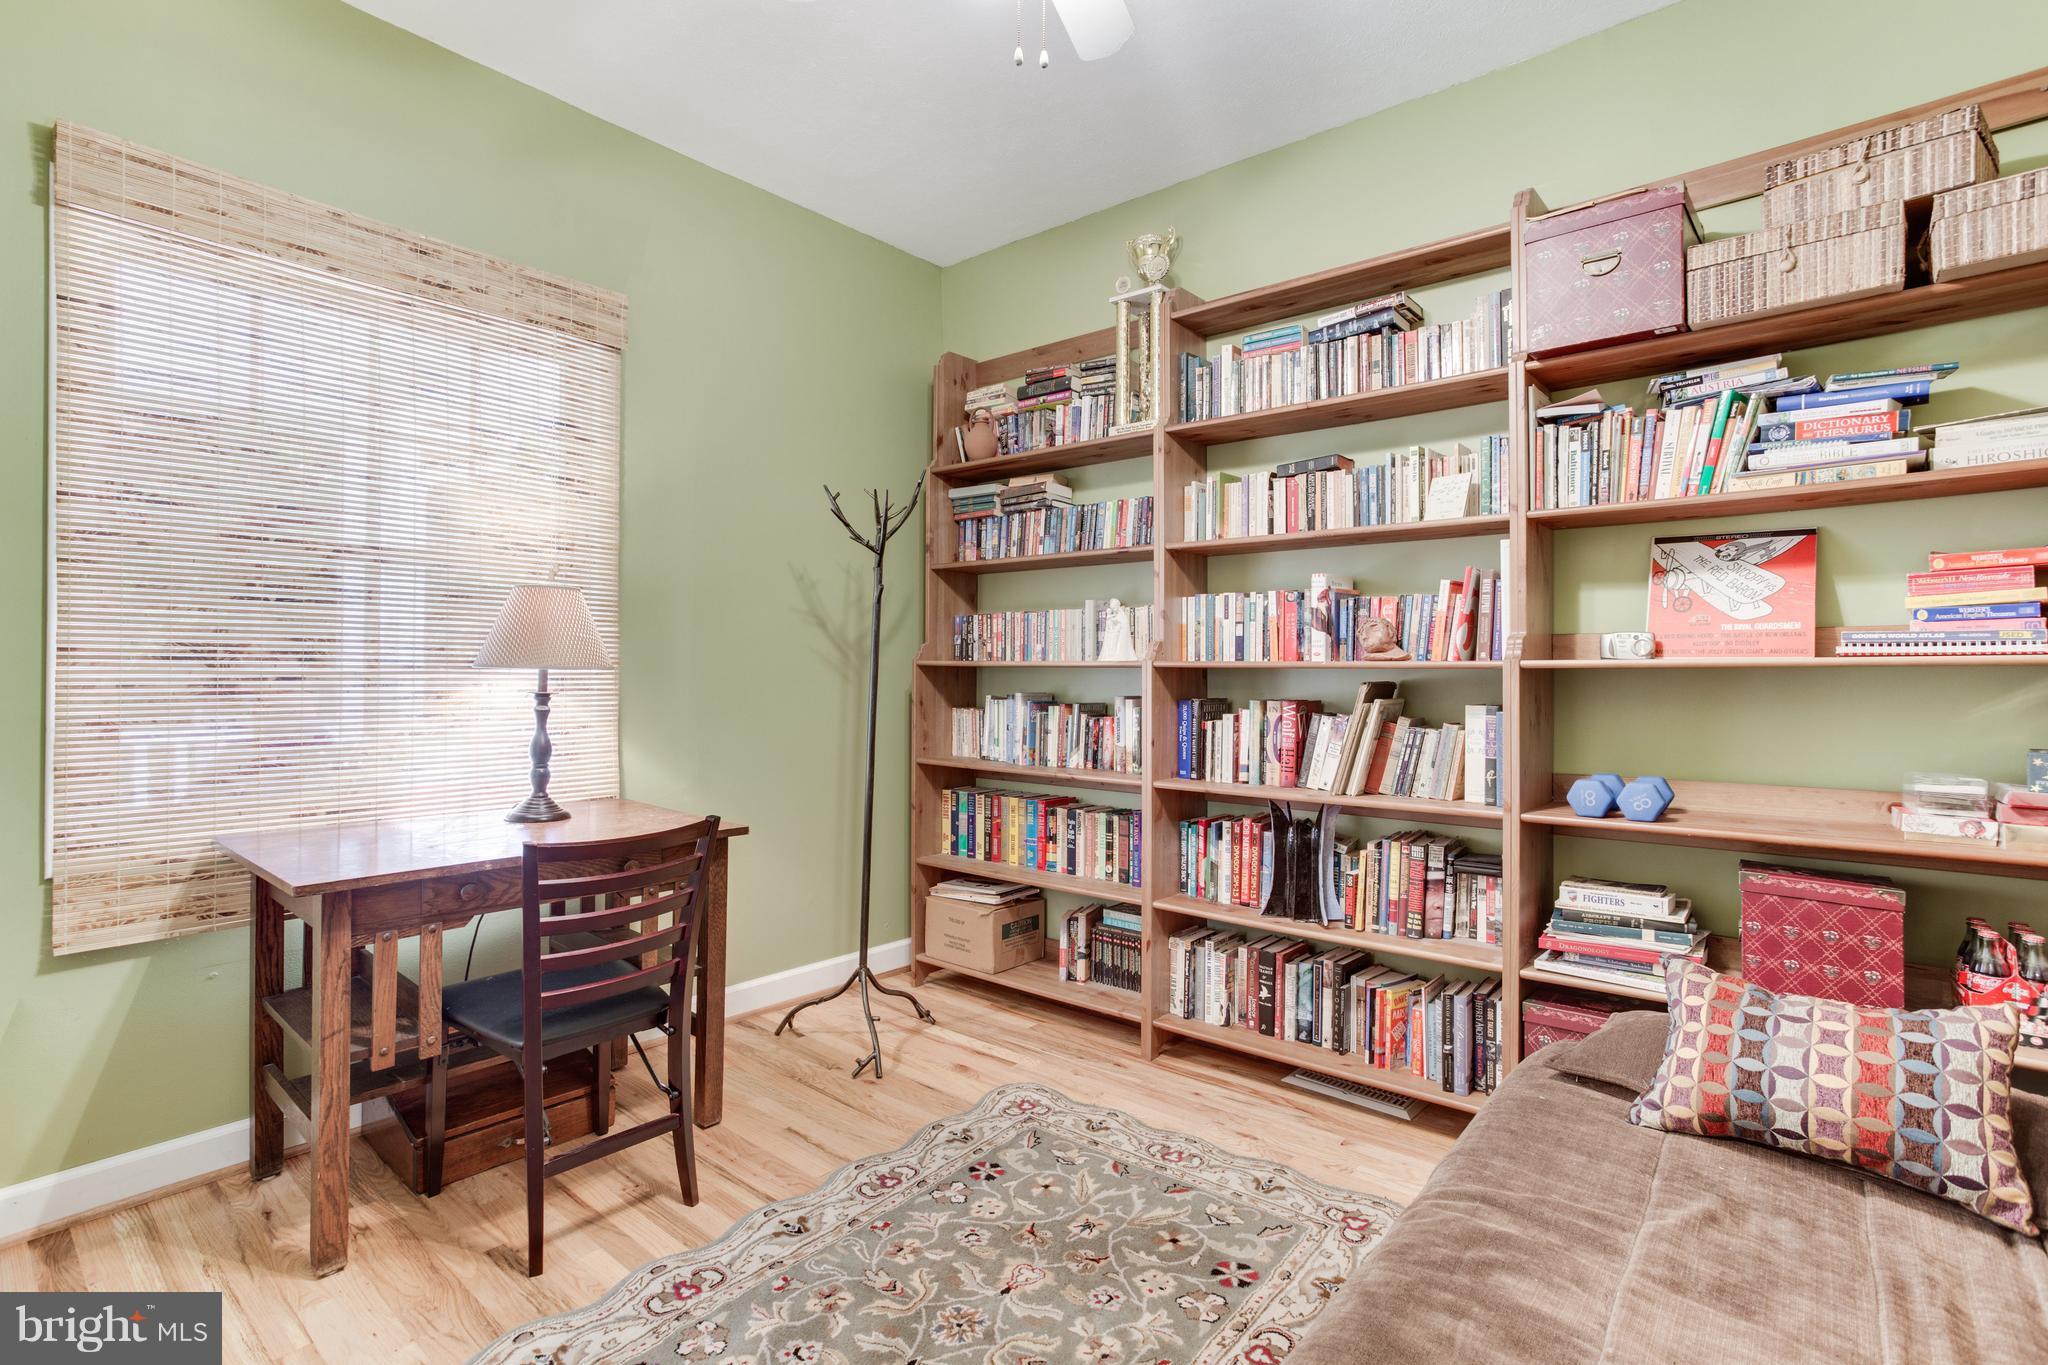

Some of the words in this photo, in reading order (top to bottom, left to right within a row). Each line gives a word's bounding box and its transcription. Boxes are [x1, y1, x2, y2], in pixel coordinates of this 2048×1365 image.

[1691, 378, 1745, 395] AUSTRIA
[1803, 414, 1890, 431] DICTIONARY
[1815, 423, 1891, 438] THESAURUS
[1661, 442, 1673, 476] SURVIVAL
[1820, 447, 1858, 458] BIBLE
[1693, 554, 1711, 568] THE
[1709, 564, 1728, 583] RED
[1726, 578, 1762, 600] BARON
[1726, 560, 1765, 588] SNOOPY
[1282, 704, 1296, 737] Wolf
[1282, 749, 1294, 773] Hall
[1585, 790, 1596, 806] 8
[1633, 798, 1652, 811] 8
[1583, 894, 1625, 907] FIGHTERS
[1476, 1022, 1484, 1043] ARCHER
